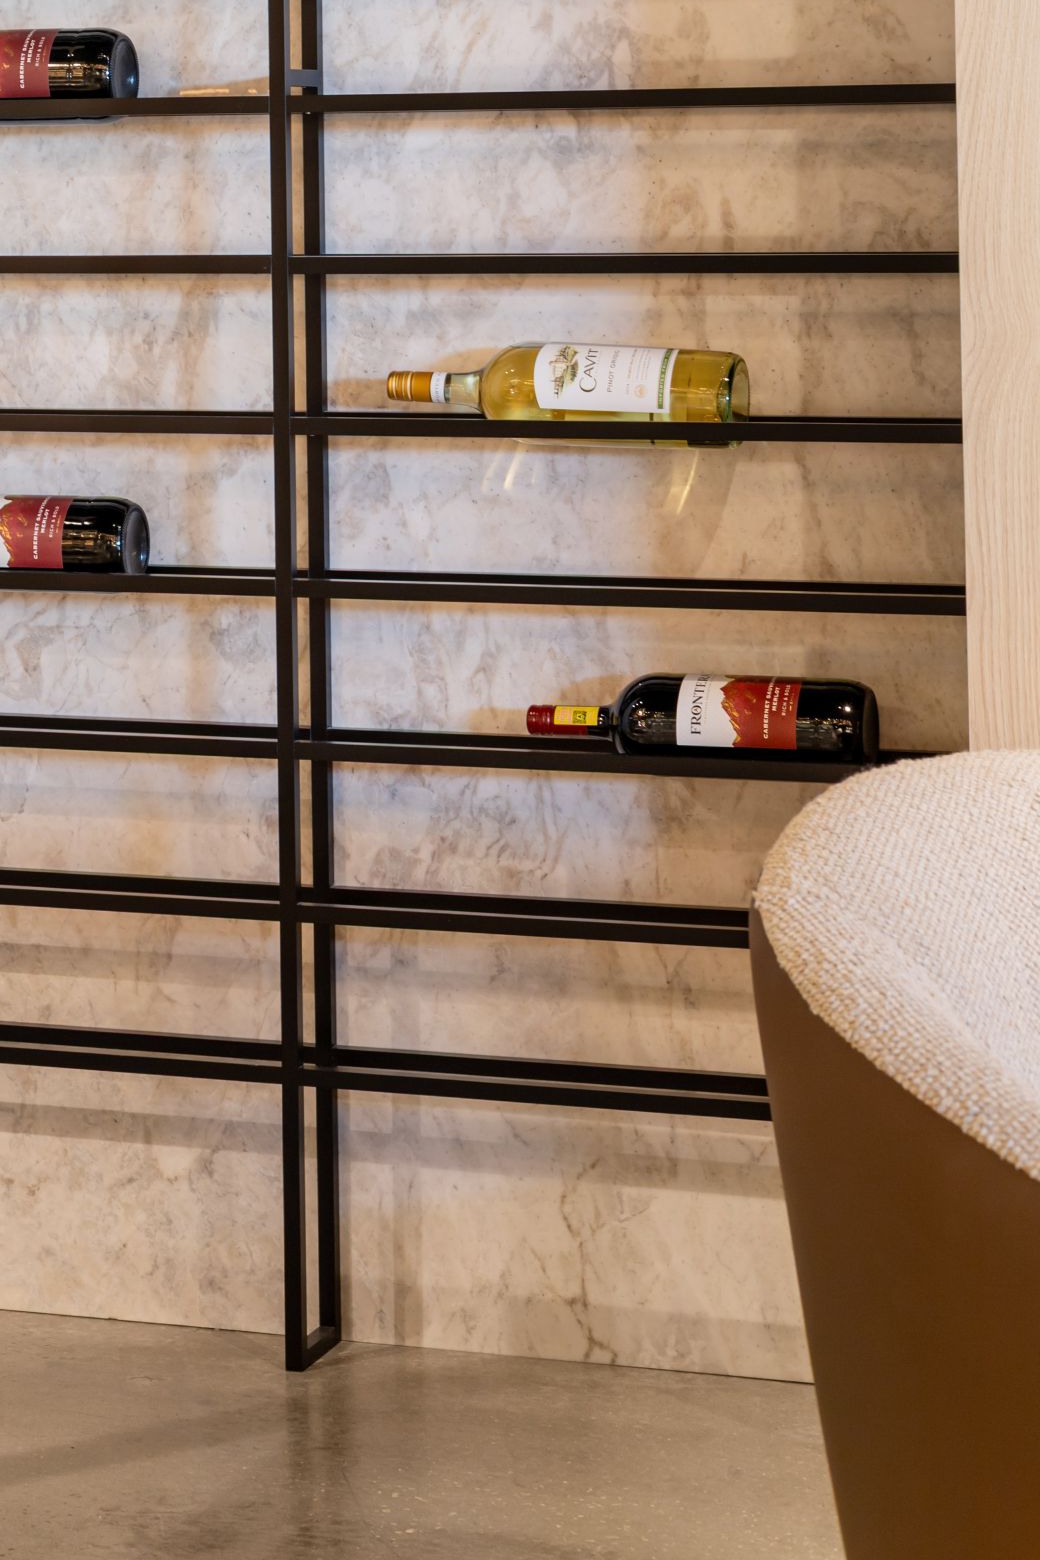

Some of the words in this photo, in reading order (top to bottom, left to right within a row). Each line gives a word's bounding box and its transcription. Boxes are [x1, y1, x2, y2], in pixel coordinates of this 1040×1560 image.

[26, 39, 35, 63] MERLOT
[578, 348, 599, 393] CAVIT
[606, 371, 614, 393] PINOT
[41, 509, 50, 533] MERLOT
[771, 686, 780, 712] MERLOT
